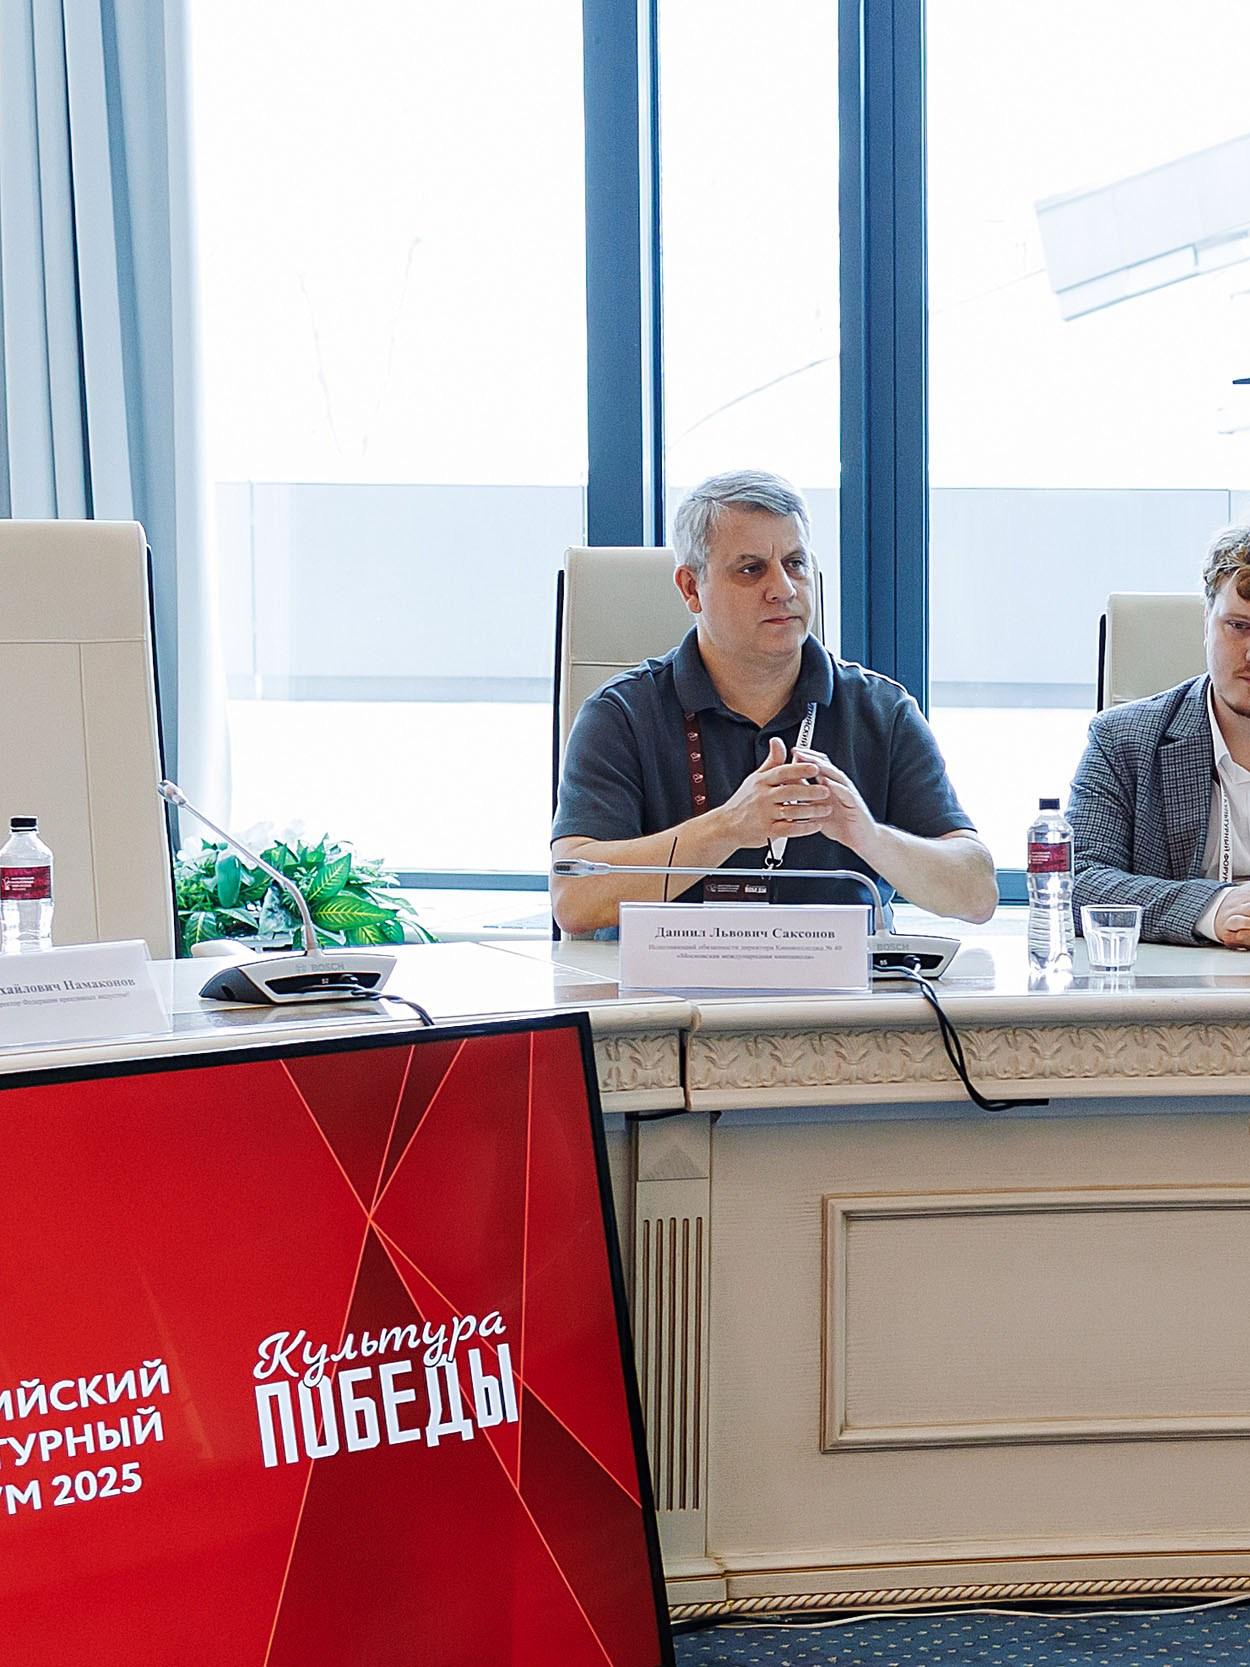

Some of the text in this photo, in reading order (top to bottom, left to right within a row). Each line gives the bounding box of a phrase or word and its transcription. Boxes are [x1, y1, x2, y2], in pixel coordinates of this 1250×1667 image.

[655, 927, 836, 939] Даниил Львович Саксонов
[877, 943, 909, 951] BOSCH
[311, 963, 344, 972] BOSCH
[64, 978, 136, 991] Намаконов
[253, 1310, 507, 1388] Культура
[254, 1343, 519, 1468] ПОБЕДЫ
[0, 1462, 142, 1515] М 2025
